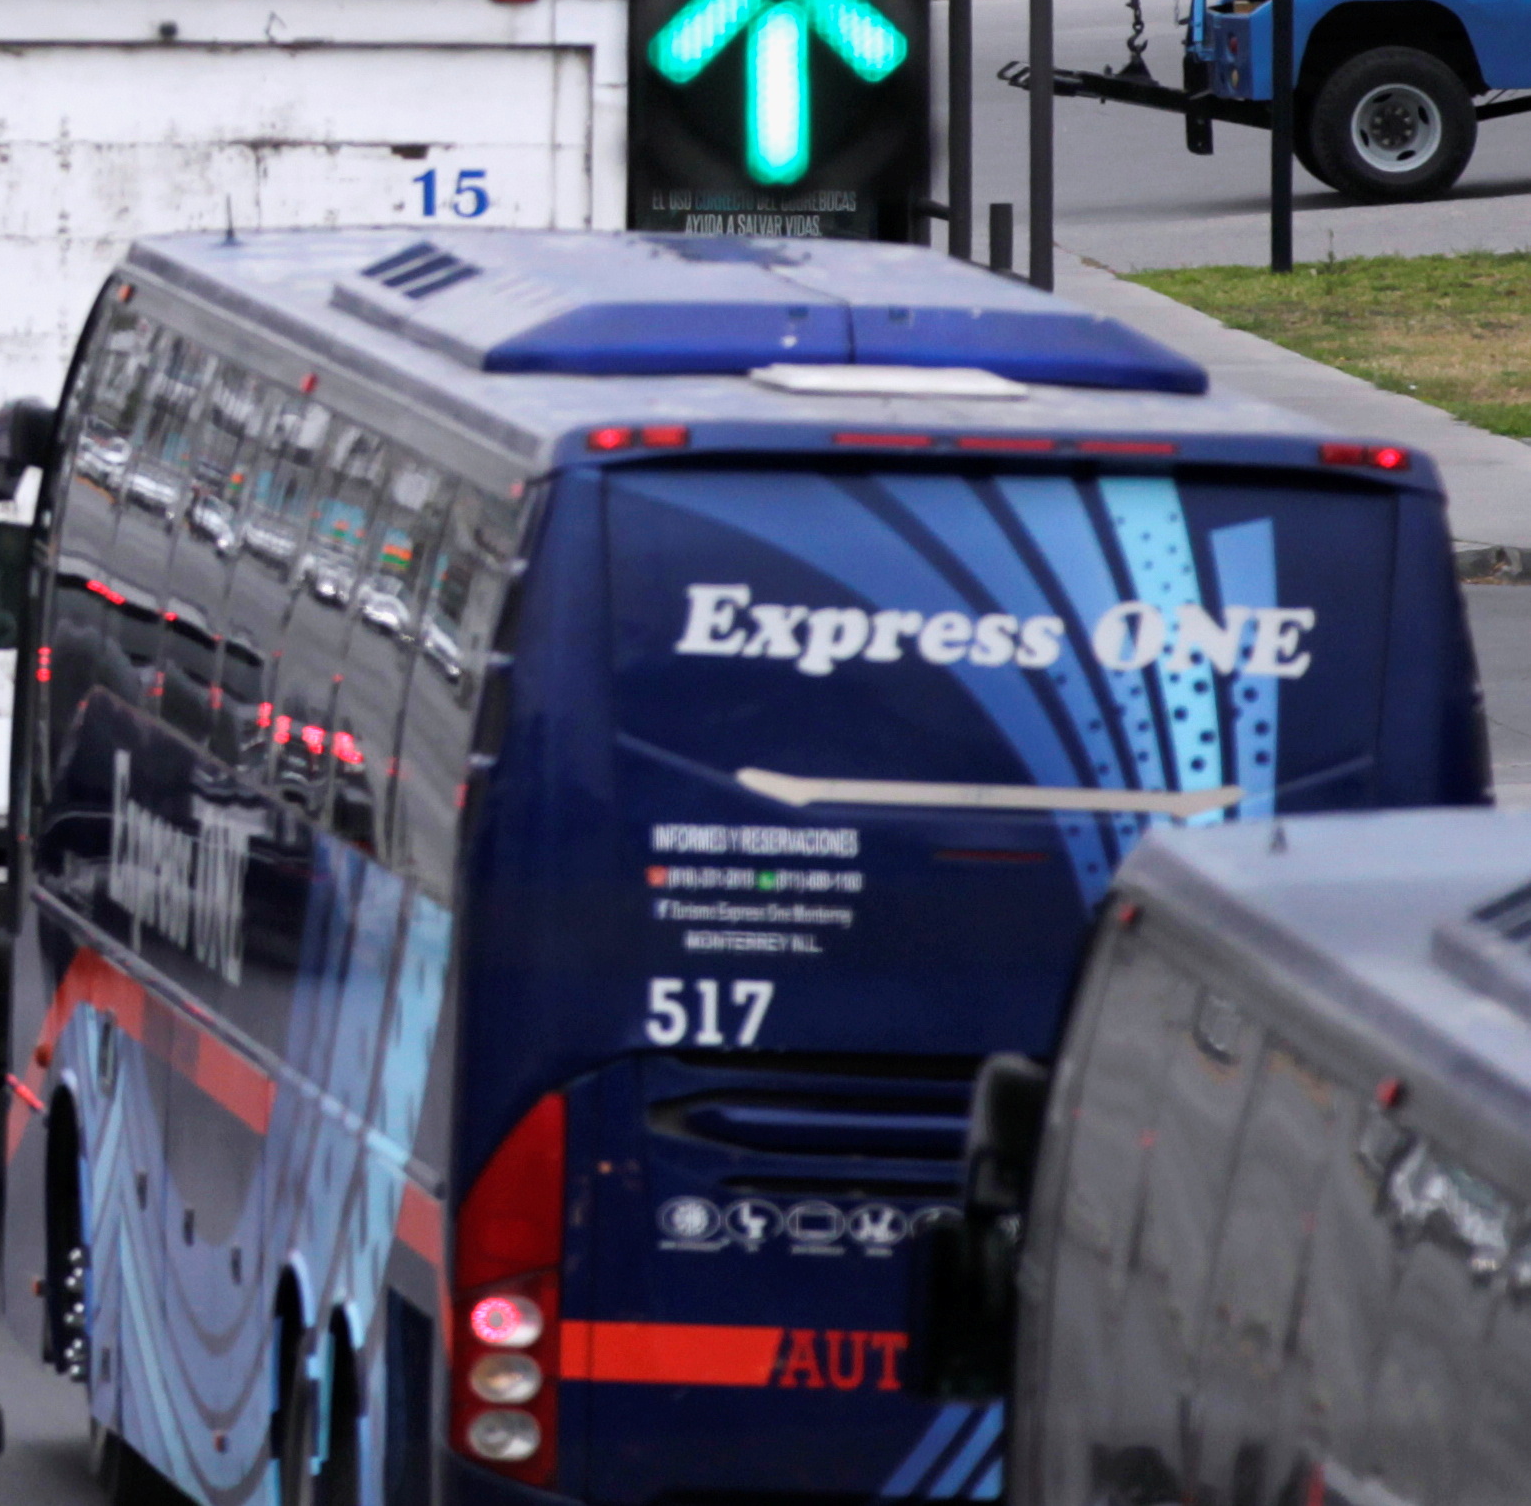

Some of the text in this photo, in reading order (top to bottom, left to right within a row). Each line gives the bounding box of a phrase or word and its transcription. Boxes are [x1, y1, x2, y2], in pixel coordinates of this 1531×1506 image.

[413, 168, 489, 218] 15
[669, 192, 692, 211] USO
[685, 213, 724, 236] AYUDA
[727, 214, 735, 236] A
[737, 214, 783, 236] SALVAR
[675, 583, 1316, 678] Express ONE
[653, 823, 727, 854] INFORMES
[740, 824, 859, 859] RESERVACIONES
[645, 977, 775, 1047] 517
[778, 1327, 909, 1392] AUT
